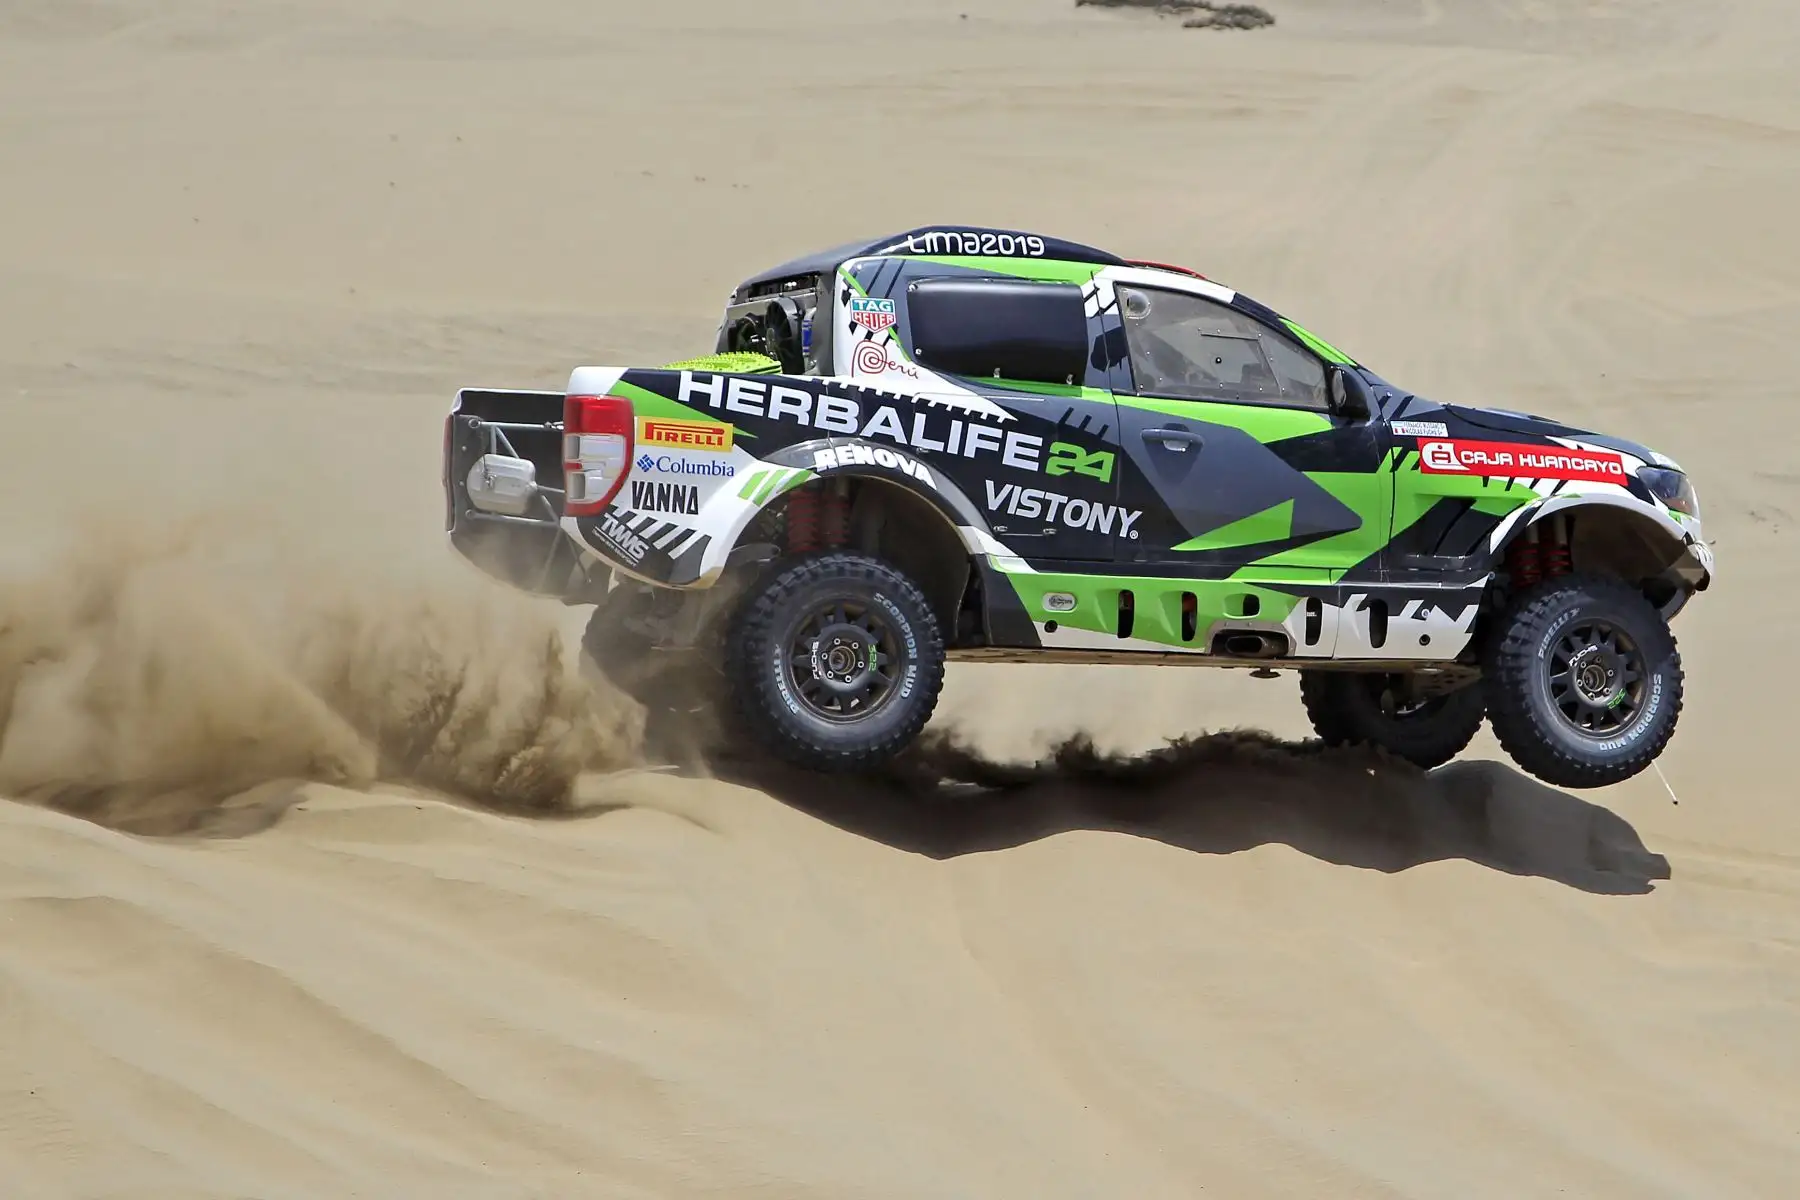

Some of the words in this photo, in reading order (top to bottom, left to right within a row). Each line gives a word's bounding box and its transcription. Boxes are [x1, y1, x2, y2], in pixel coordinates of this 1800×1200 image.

[855, 302, 894, 312] TAG
[853, 313, 895, 331] HEUER
[644, 422, 725, 446] PIRELLI
[678, 371, 1043, 471] HERBALIFE
[1045, 442, 1115, 483] 24
[656, 456, 735, 477] Columbia
[813, 443, 937, 490] RENOVA
[1461, 450, 1514, 466] CAJA
[1520, 456, 1622, 476] HUANCAYO
[632, 481, 699, 515] VANNA
[900, 665, 917, 698] MUD
[1630, 674, 1662, 740] SCORPION
